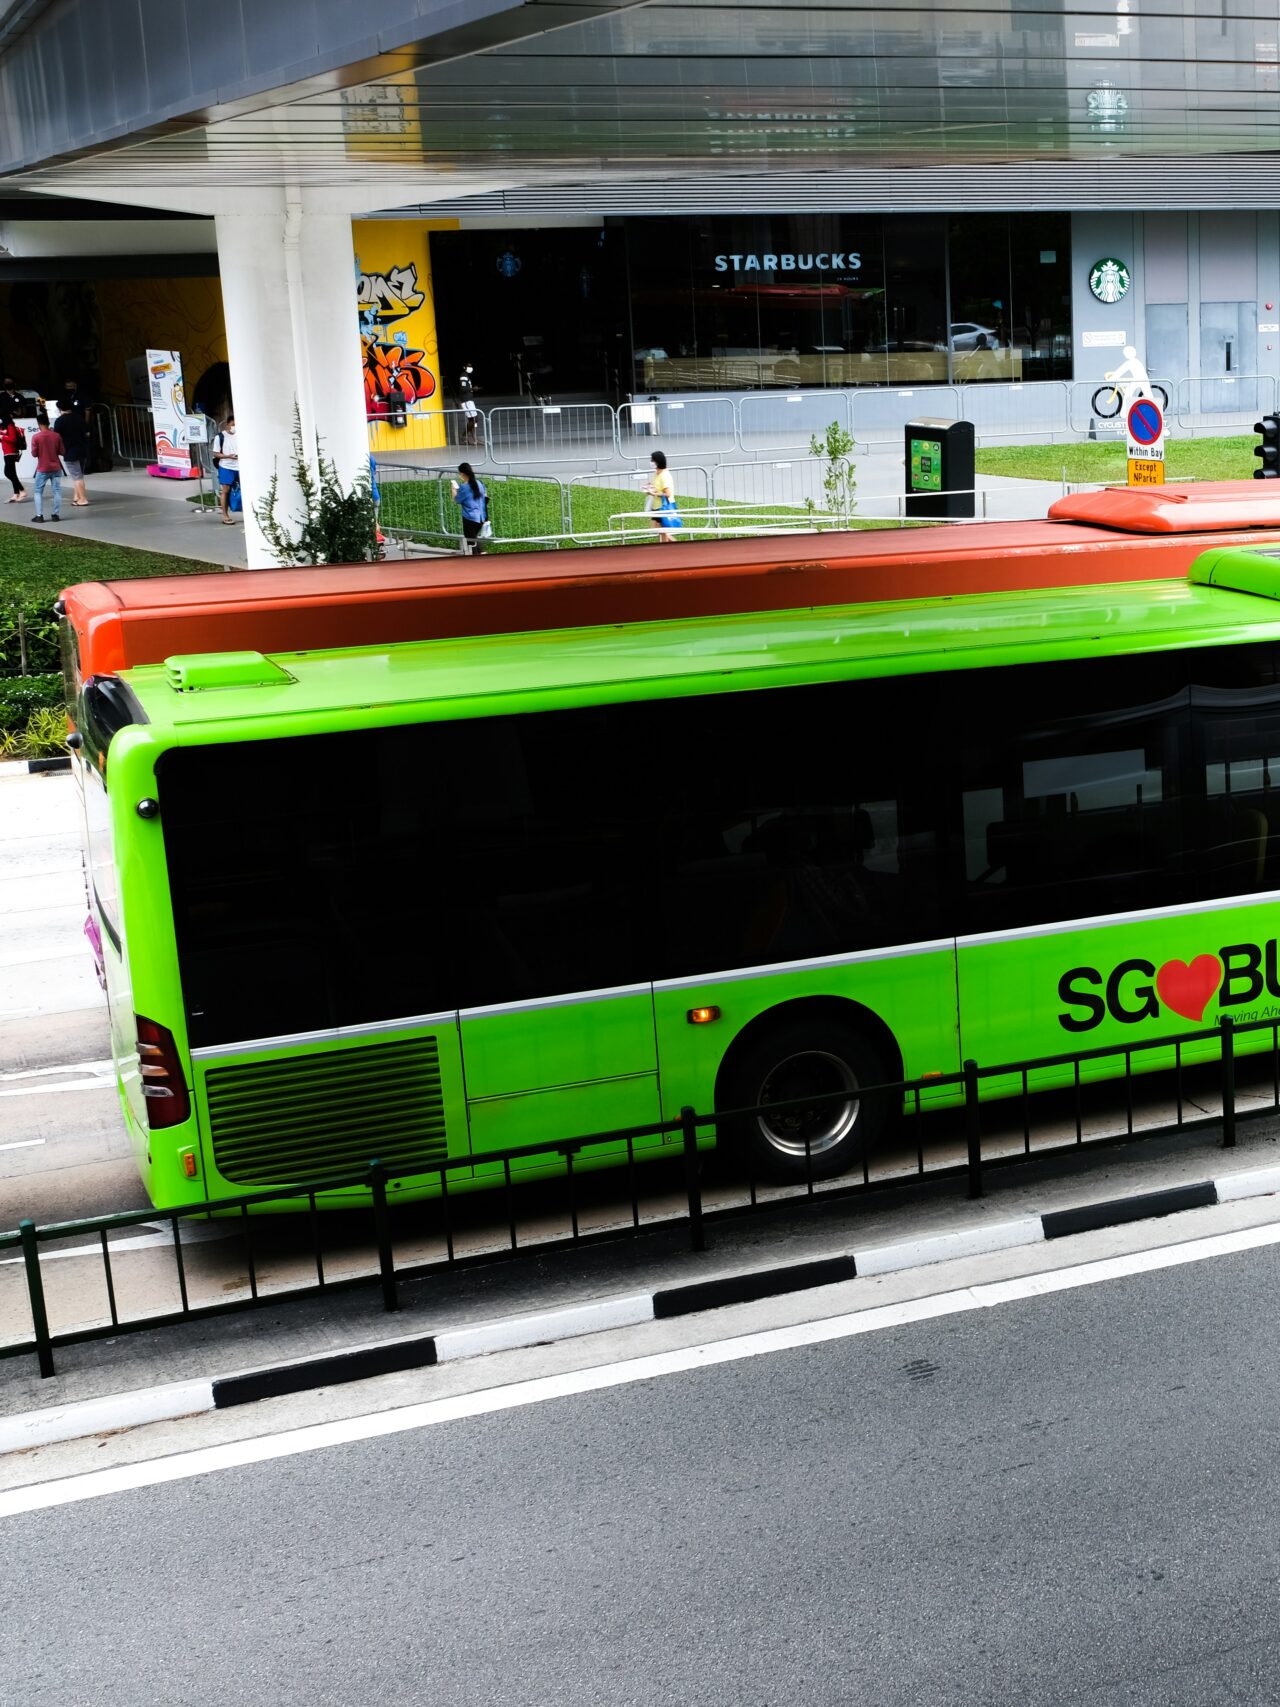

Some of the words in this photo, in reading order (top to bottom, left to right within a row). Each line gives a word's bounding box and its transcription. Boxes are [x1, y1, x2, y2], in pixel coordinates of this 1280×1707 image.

[715, 252, 862, 272] STARBUCKS
[1128, 446, 1148, 457] Within
[1151, 448, 1163, 459] Bay
[1134, 461, 1157, 472] Except
[1058, 958, 1159, 1033] SG
[1214, 1009, 1258, 1026] Mving
